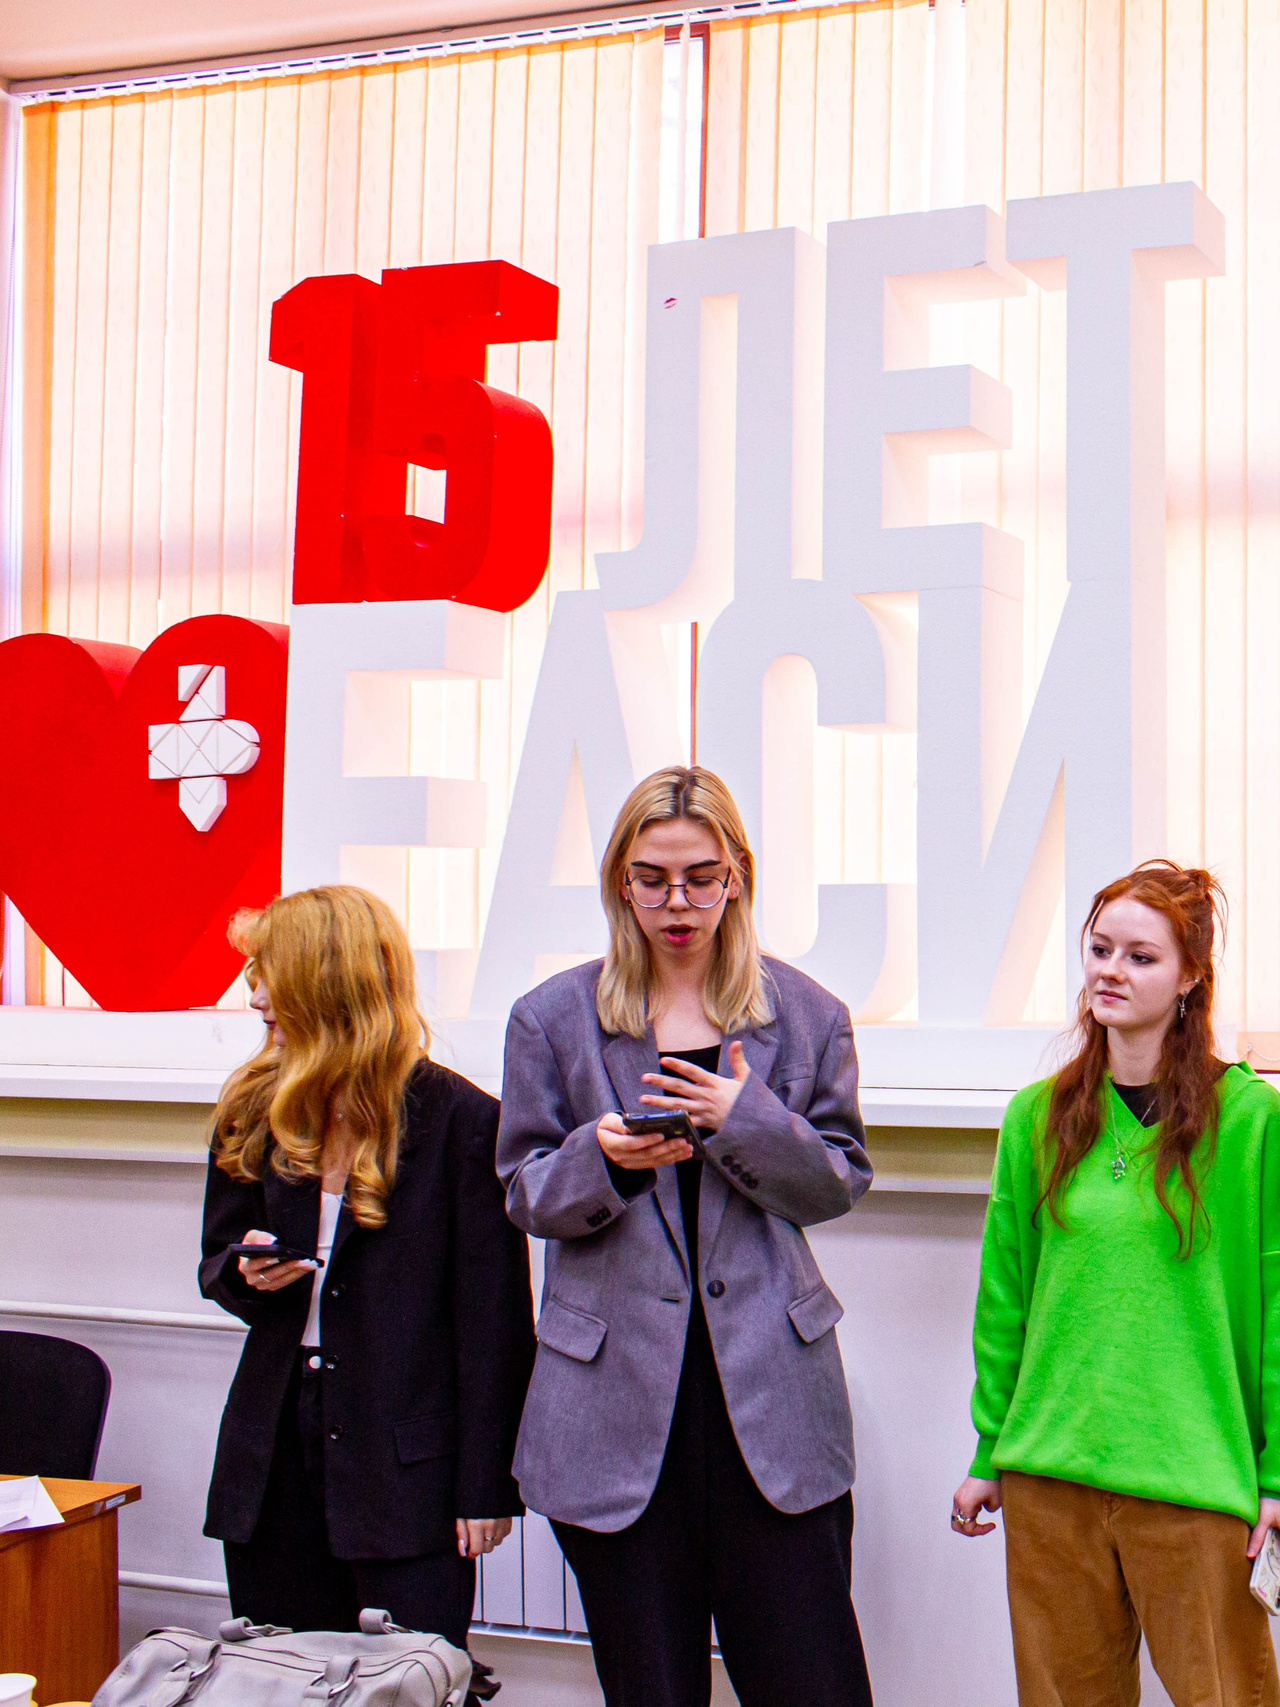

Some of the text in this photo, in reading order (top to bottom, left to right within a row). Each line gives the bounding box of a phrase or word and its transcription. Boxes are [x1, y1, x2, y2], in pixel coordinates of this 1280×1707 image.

[269, 181, 1225, 612] 15 ЛЕТ
[281, 580, 1168, 1028] ЕАСИ
